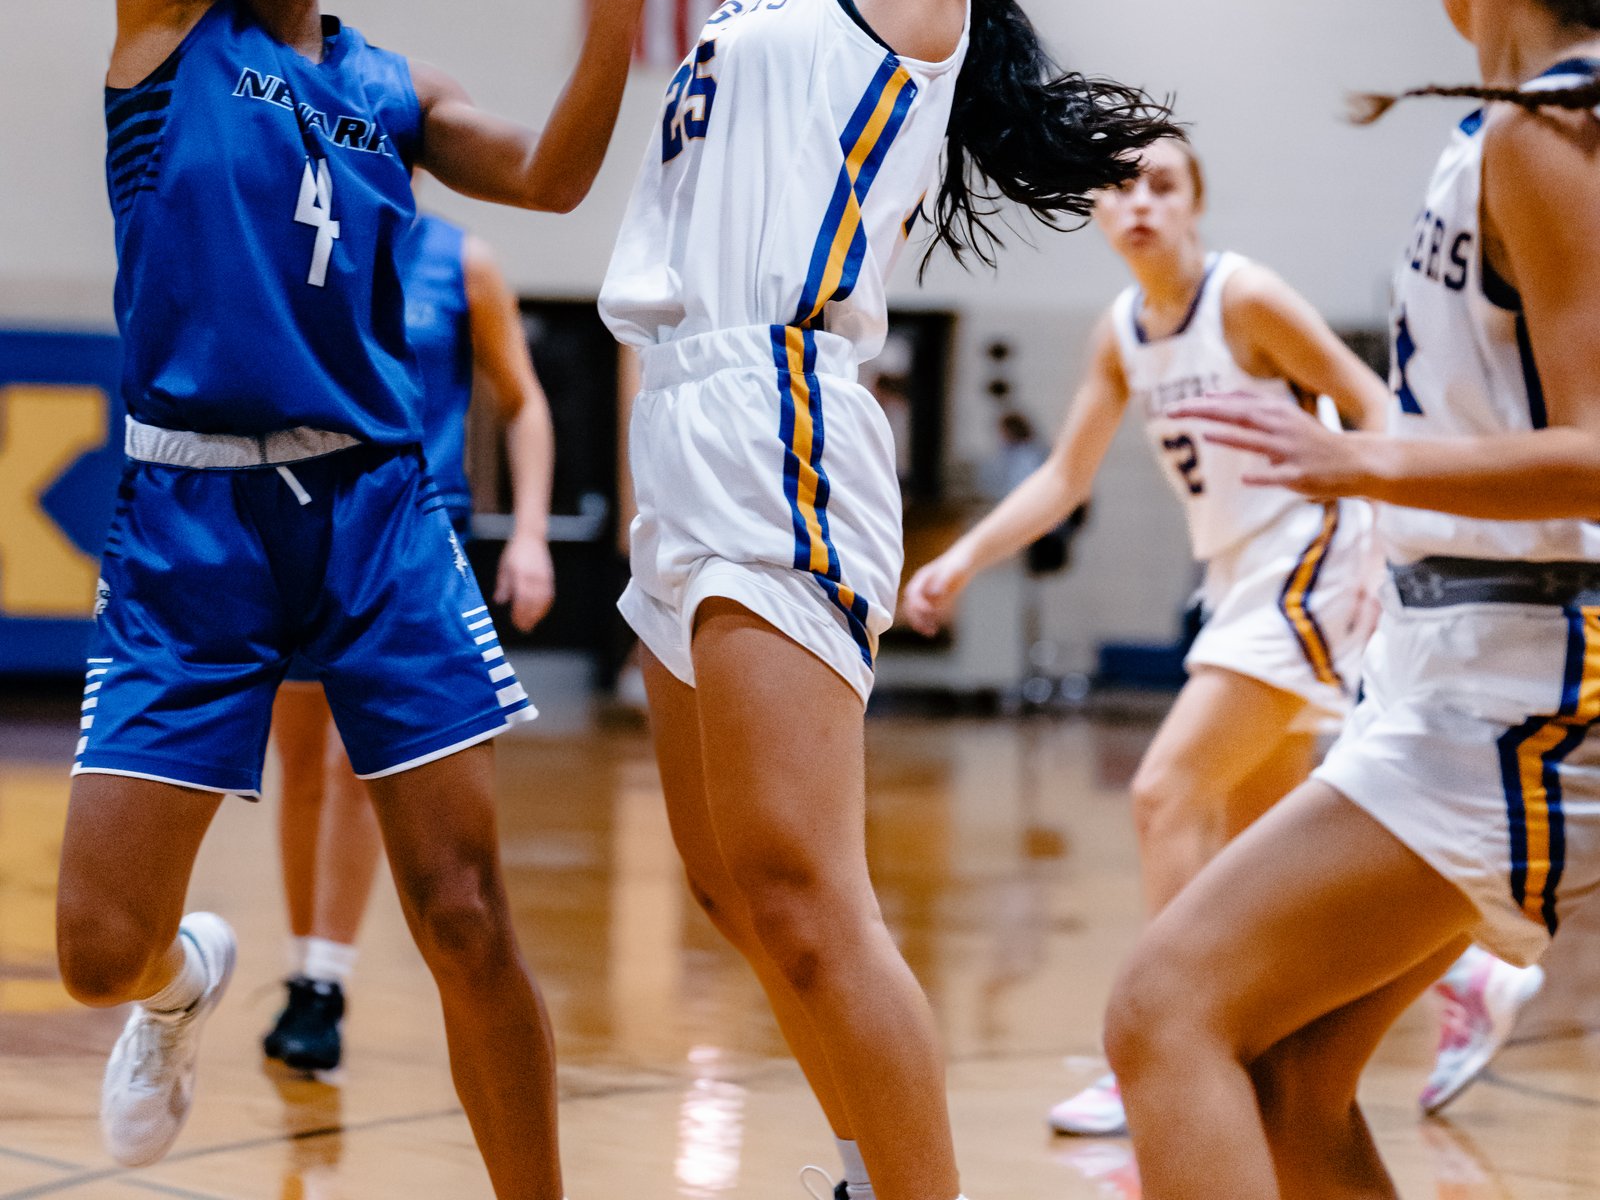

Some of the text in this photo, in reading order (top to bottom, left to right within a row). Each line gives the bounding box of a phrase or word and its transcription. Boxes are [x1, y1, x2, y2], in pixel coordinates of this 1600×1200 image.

[232, 66, 394, 157] NEARK
[661, 37, 717, 166] 25
[293, 154, 340, 288] 4
